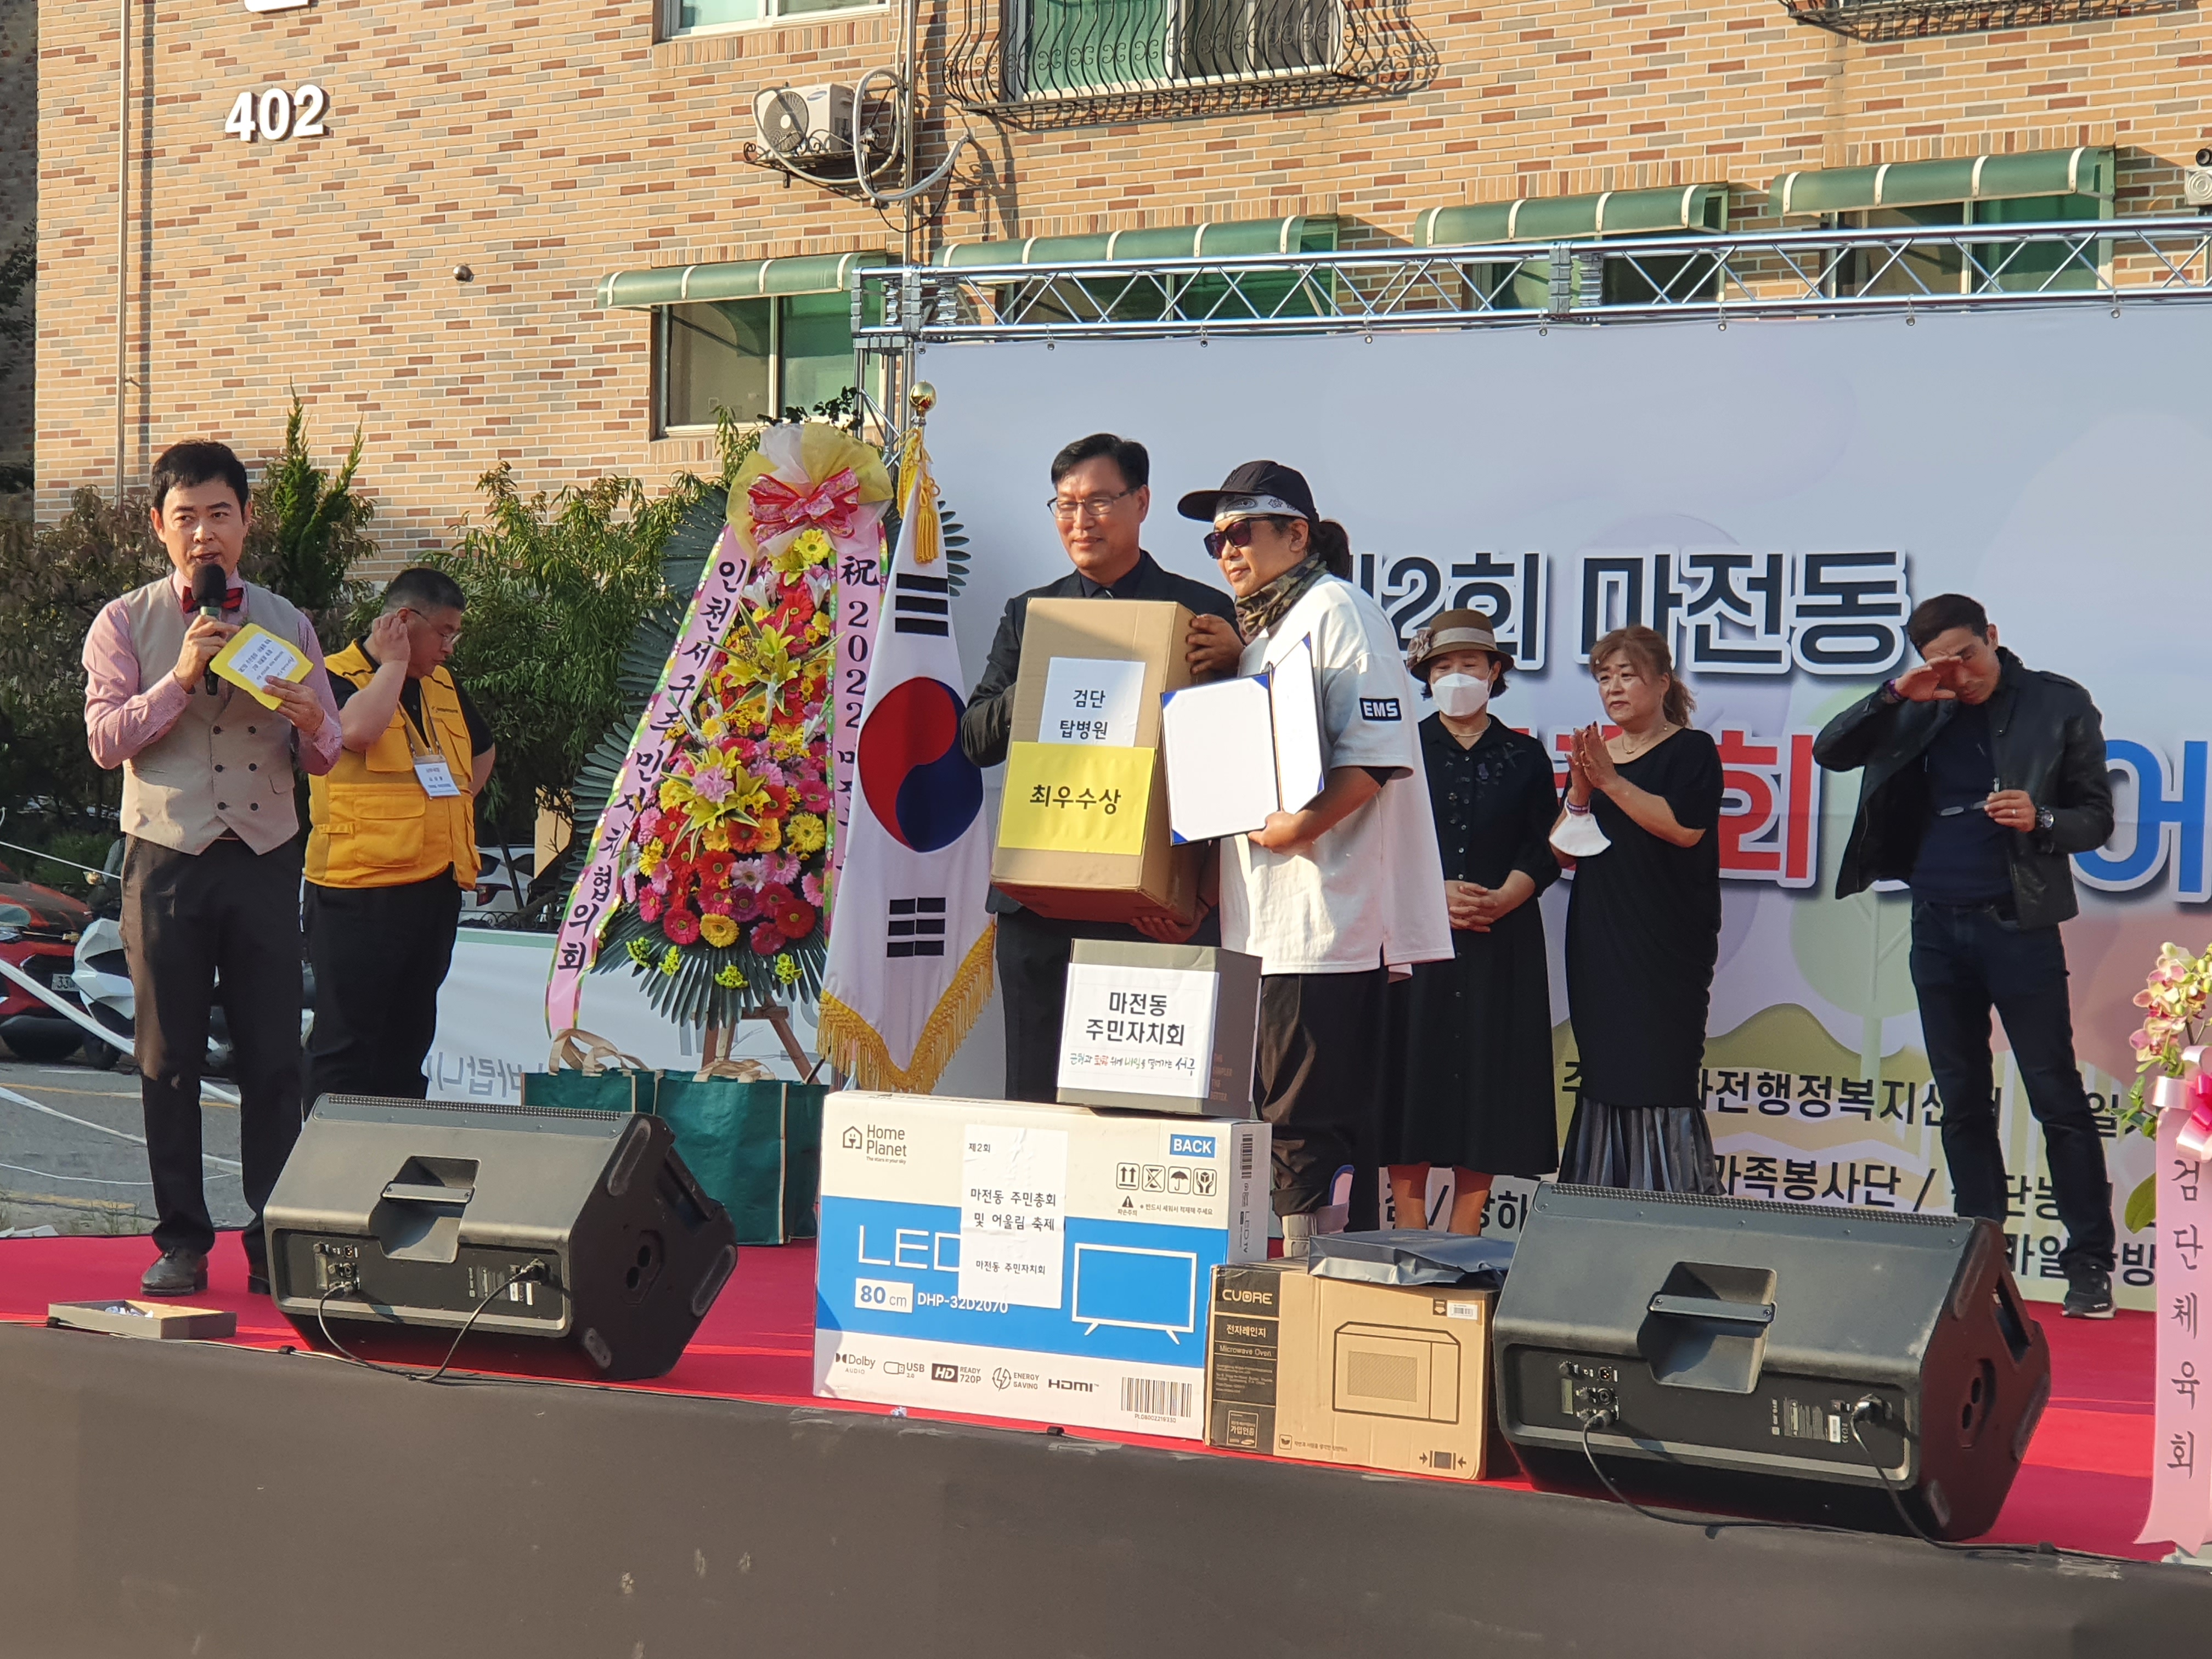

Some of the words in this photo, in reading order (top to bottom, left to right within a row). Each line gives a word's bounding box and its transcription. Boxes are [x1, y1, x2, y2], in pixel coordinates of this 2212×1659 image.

[225, 85, 326, 143] 402
[840, 555, 879, 587] 祝
[1582, 550, 1902, 665] 마전동
[1073, 689, 1106, 709] 검단
[1363, 701, 1398, 718] EMS
[1059, 719, 1109, 740] 탑병원
[1029, 785, 1121, 815] 최우수상
[1109, 992, 1167, 1017] 마전동
[1086, 1018, 1185, 1047] 주민자치회
[867, 1124, 905, 1141] Home
[866, 1139, 907, 1157] Planet
[968, 1142, 991, 1153] 제2회
[1173, 1138, 1212, 1154] BACK
[970, 1188, 1004, 1205] 마전동
[1011, 1191, 1056, 1208] 주민총회
[974, 1212, 984, 1227] 및
[992, 1214, 1025, 1230] 어울림
[1031, 1216, 1055, 1232] 축제
[976, 1260, 1000, 1273] 마전동
[1005, 1263, 1046, 1276] 주민자치회
[860, 1285, 886, 1304] 80
[889, 1296, 907, 1307] cm
[1222, 1289, 1273, 1305] CUORE
[2166, 1159, 2204, 1479] 검단체육회
[1226, 1324, 1266, 1338] 전자레인지
[1219, 1345, 1253, 1355] Microwave
[1255, 1348, 1272, 1357] Oven
[849, 1354, 876, 1369] Dolby
[906, 1362, 925, 1373] USB
[960, 1366, 981, 1374] READY
[934, 1367, 956, 1380] HD
[960, 1374, 981, 1384] 720P
[1013, 1372, 1040, 1381] ENERGY
[1013, 1381, 1039, 1390] SAVING
